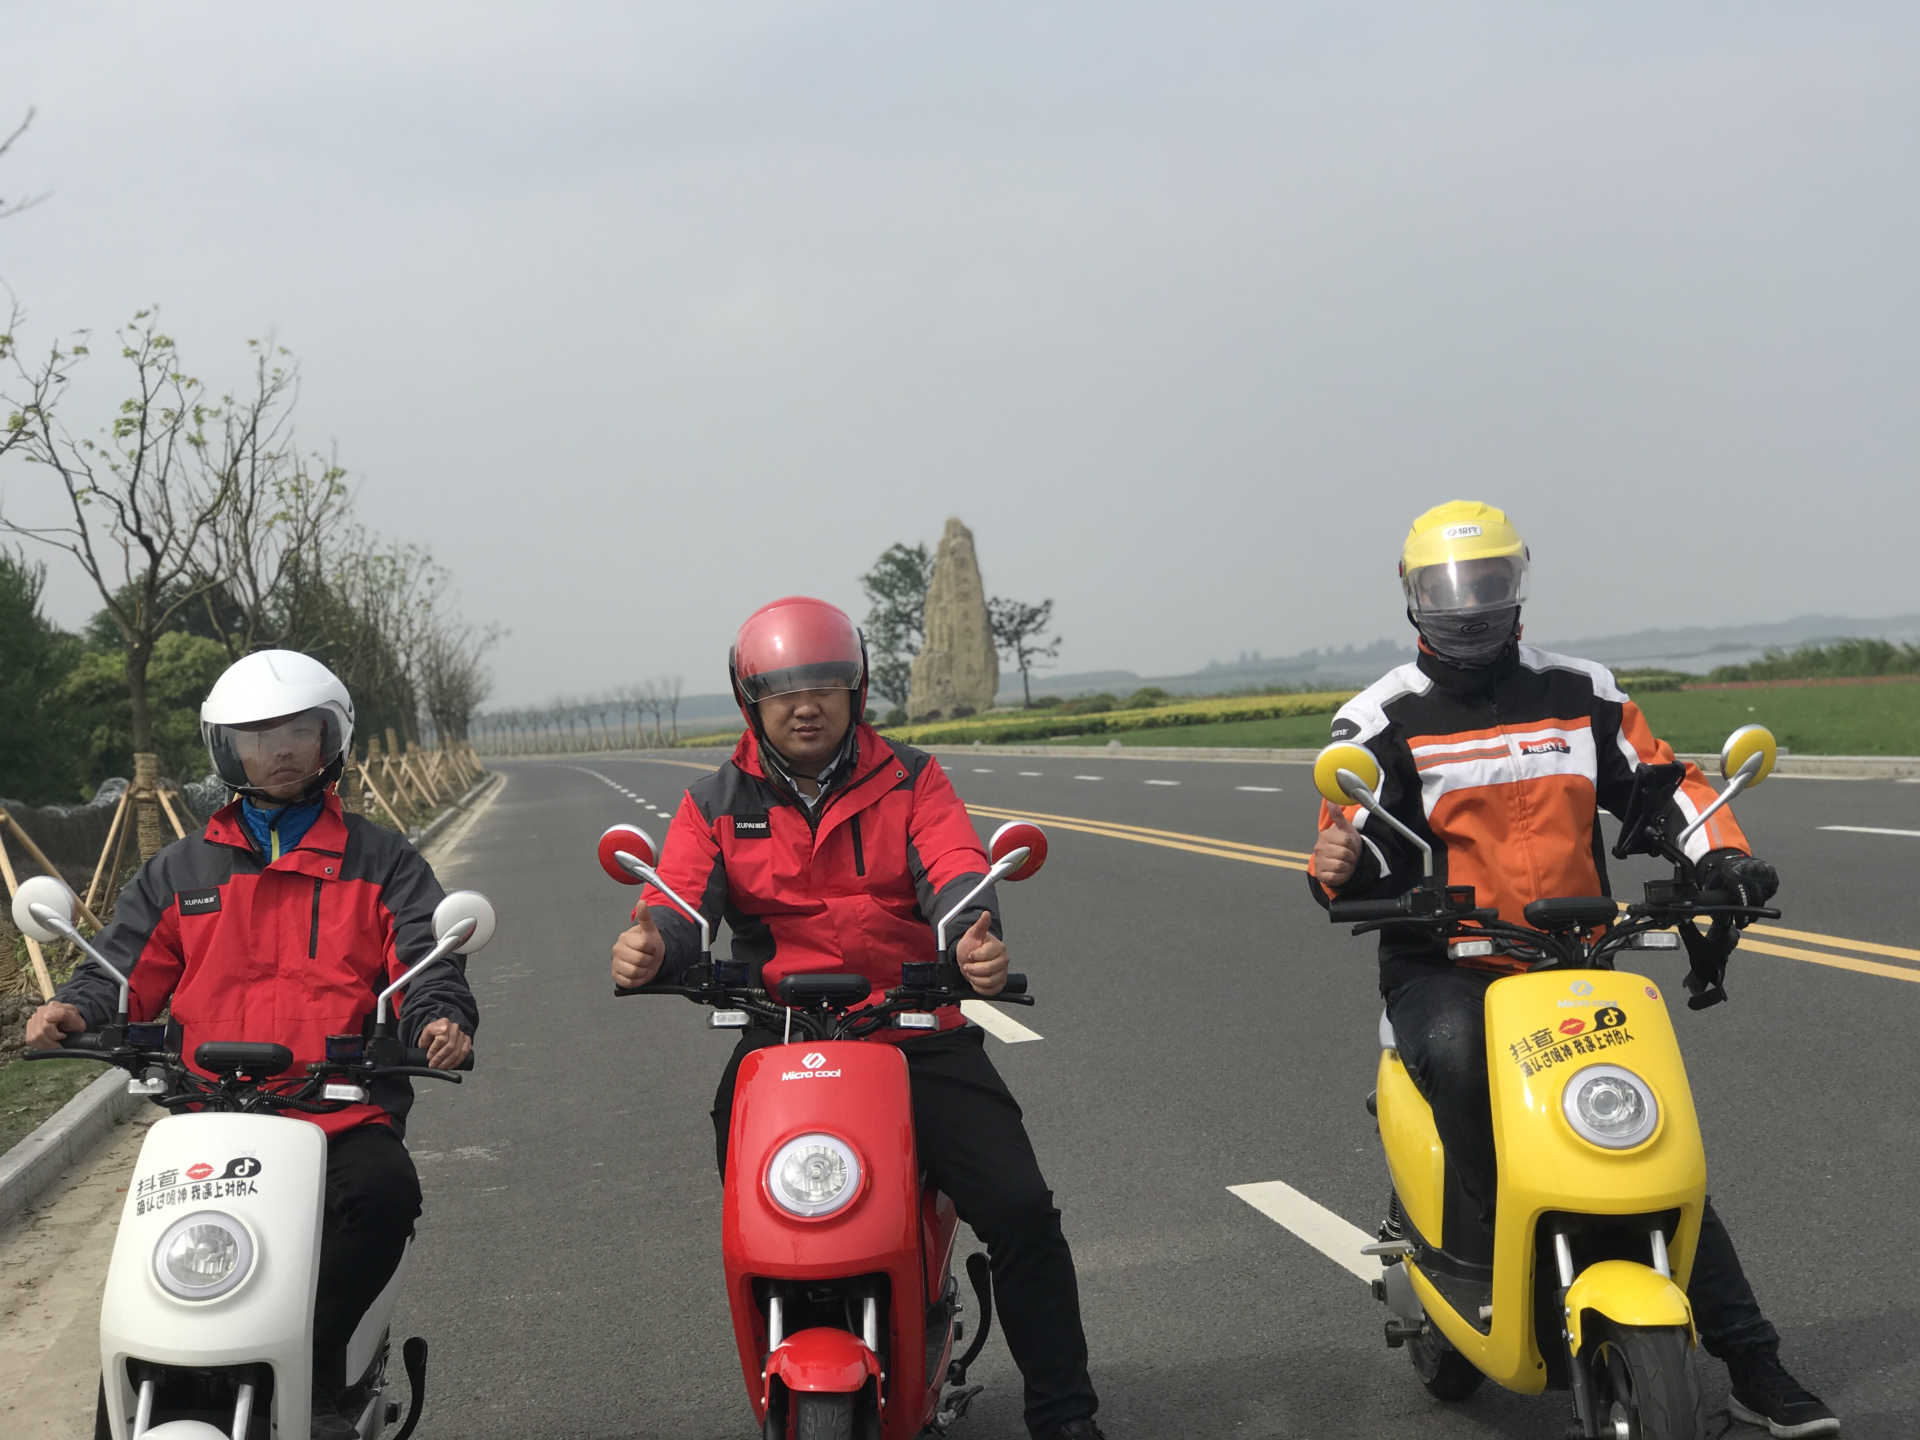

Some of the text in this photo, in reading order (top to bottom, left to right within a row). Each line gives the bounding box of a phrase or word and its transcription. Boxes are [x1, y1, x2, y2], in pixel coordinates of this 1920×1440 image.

[1527, 742, 1565, 753] NERVE
[1509, 1027, 1555, 1061] 抖音
[781, 1068, 841, 1082] Micro cool
[137, 1168, 180, 1197] 抖音
